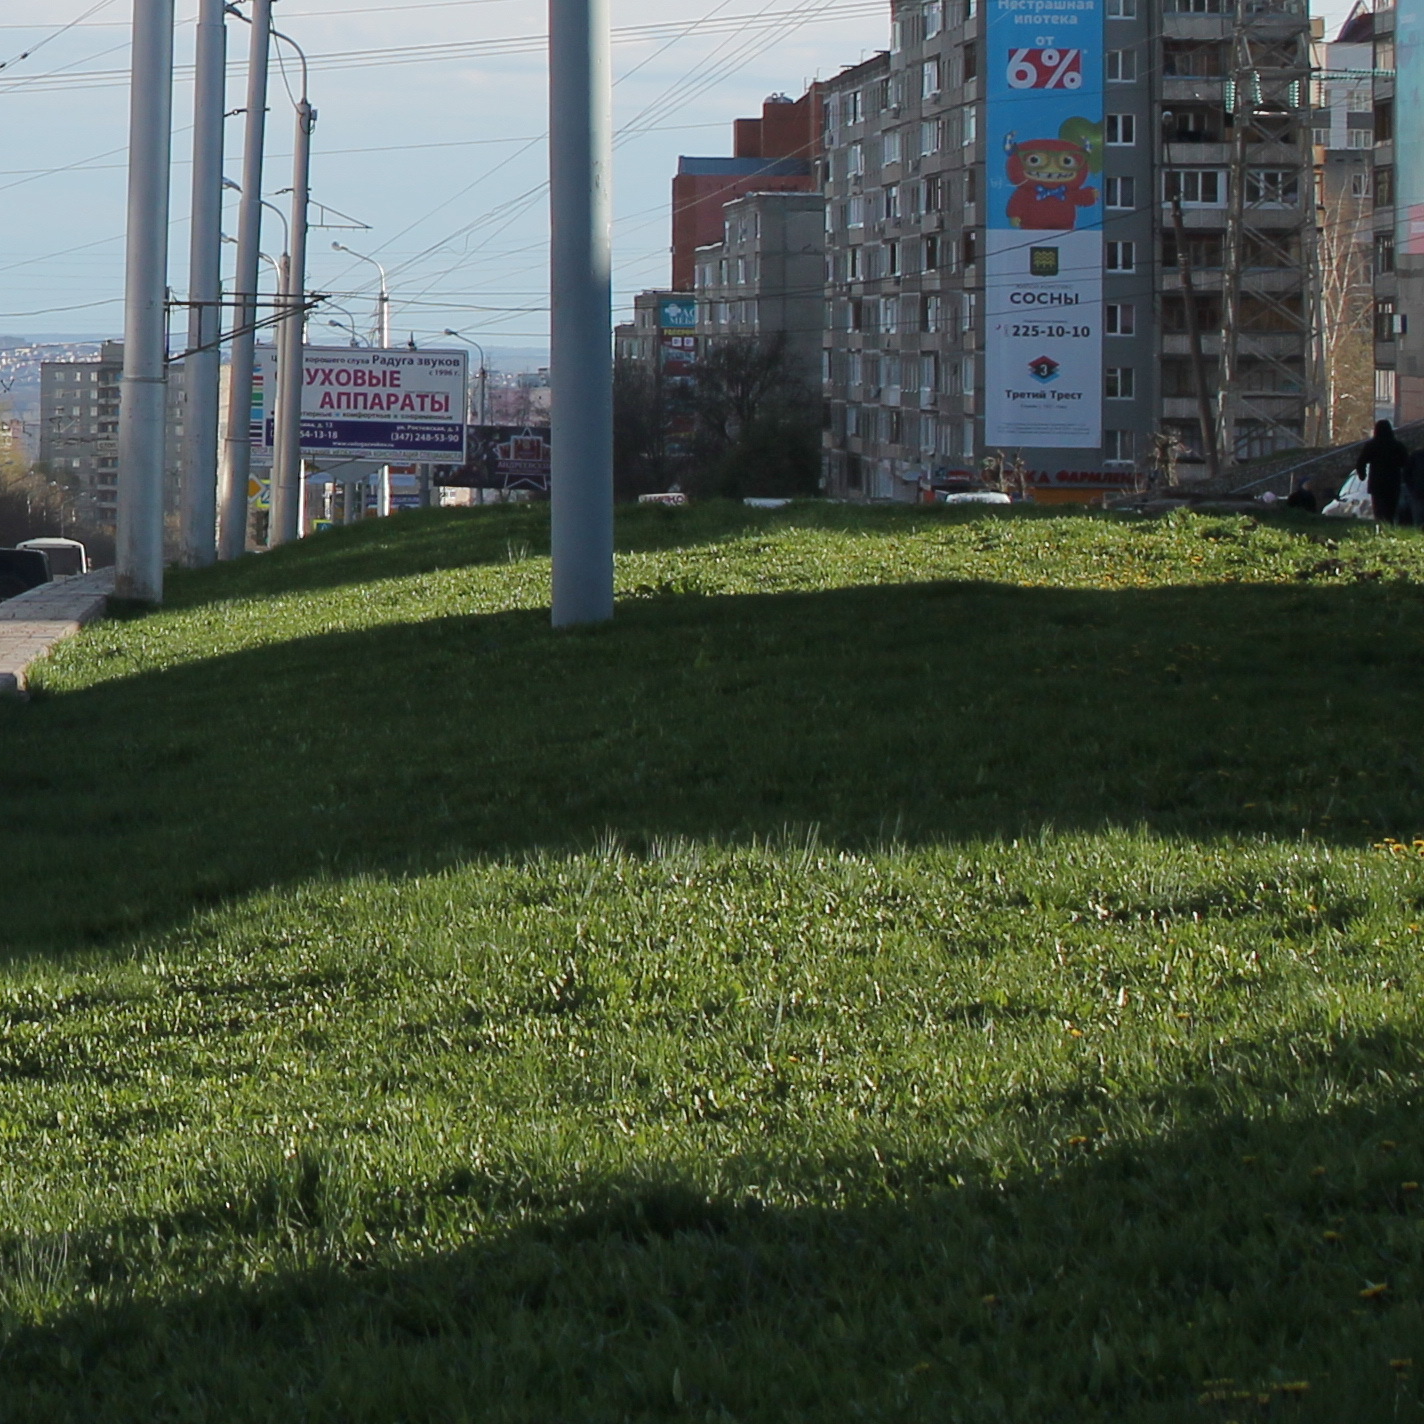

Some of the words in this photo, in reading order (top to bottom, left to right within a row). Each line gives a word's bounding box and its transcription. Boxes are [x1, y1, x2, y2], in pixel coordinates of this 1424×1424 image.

[1014, 15, 1078, 25] ипотека
[1035, 36, 1055, 46] от
[1010, 292, 1079, 305] СОСНЫ
[1012, 325, 1090, 337] 225-10-10
[305, 356, 345, 365] хорошего
[372, 355, 413, 367] Радуга
[417, 358, 460, 367] звуков
[275, 368, 401, 387] УХОВЫЕ
[319, 391, 450, 412] АППАРАТЫ
[1006, 390, 1046, 401] Третий
[1050, 390, 1083, 402] Трест
[300, 430, 338, 439] 54-13-18
[391, 433, 413, 442] (347)
[415, 433, 459, 442] 248-53-90
